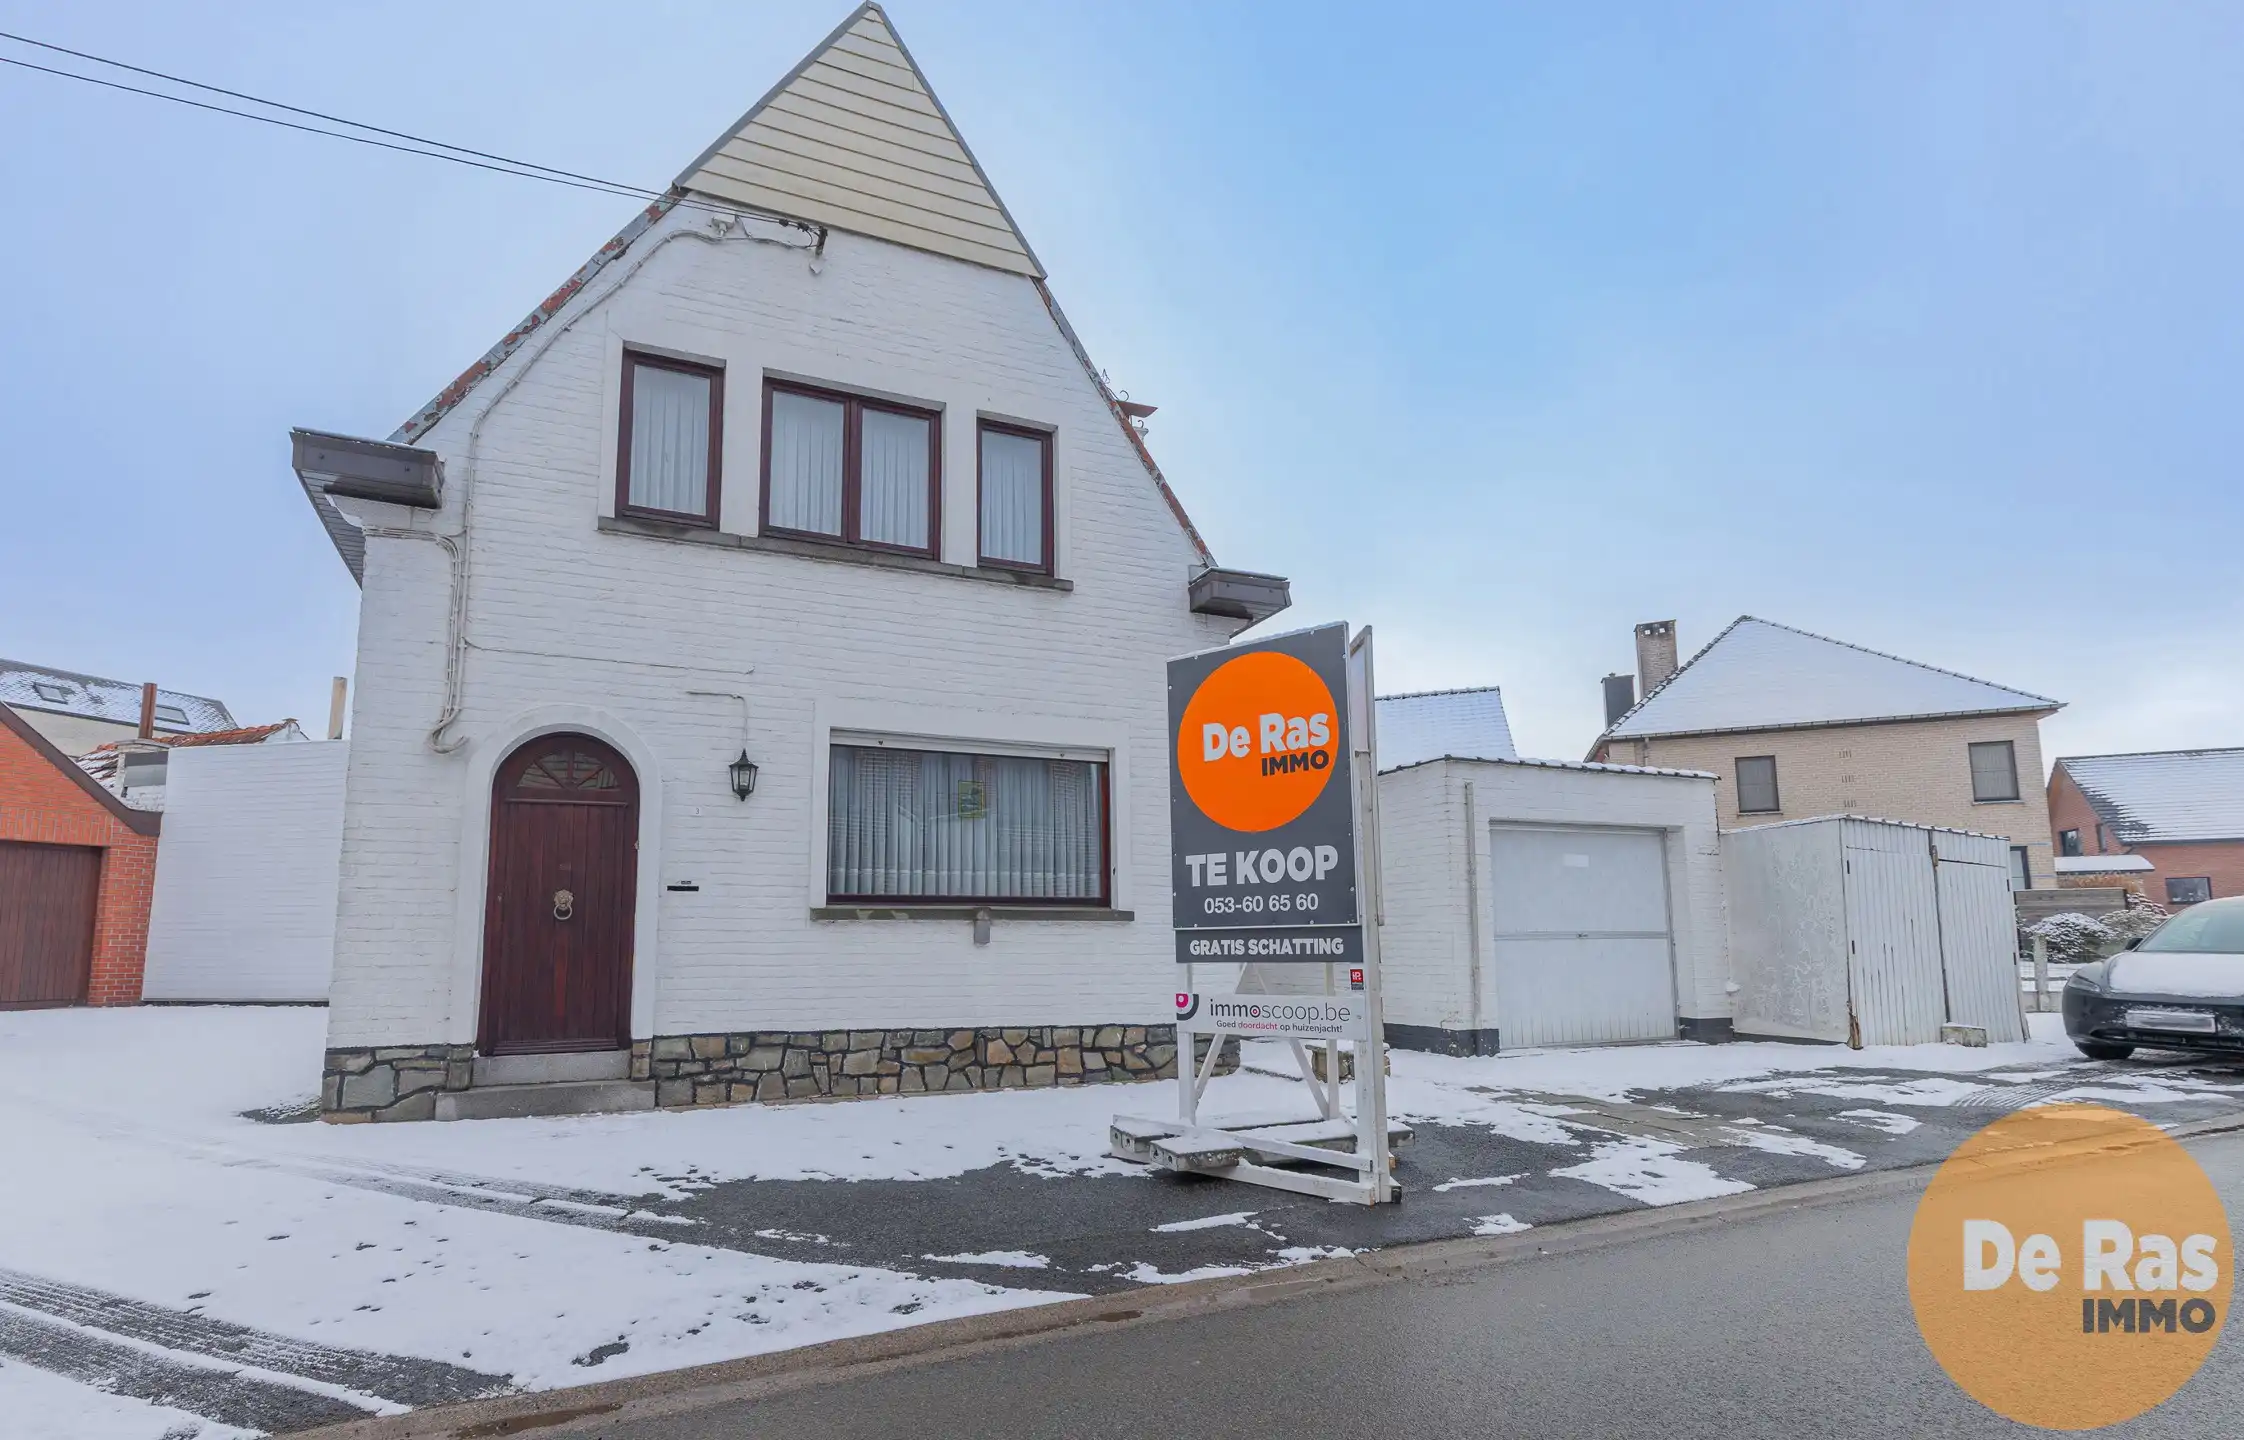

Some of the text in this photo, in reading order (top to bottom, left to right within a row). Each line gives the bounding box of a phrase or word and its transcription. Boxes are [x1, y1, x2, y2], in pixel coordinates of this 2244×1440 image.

[1203, 713, 1330, 762] De Ras
[1261, 750, 1329, 776] IMMO
[1185, 845, 1338, 887] TE KOOP
[1204, 893, 1319, 914] 053-60 65 60
[1189, 938, 1344, 955] GRATIS SCHATTING
[1210, 998, 1350, 1024] immoscoop.be
[1216, 1020, 1236, 1028] Goed
[1238, 1021, 1278, 1030] doordacht
[1292, 1023, 1342, 1033] huizenjacht!
